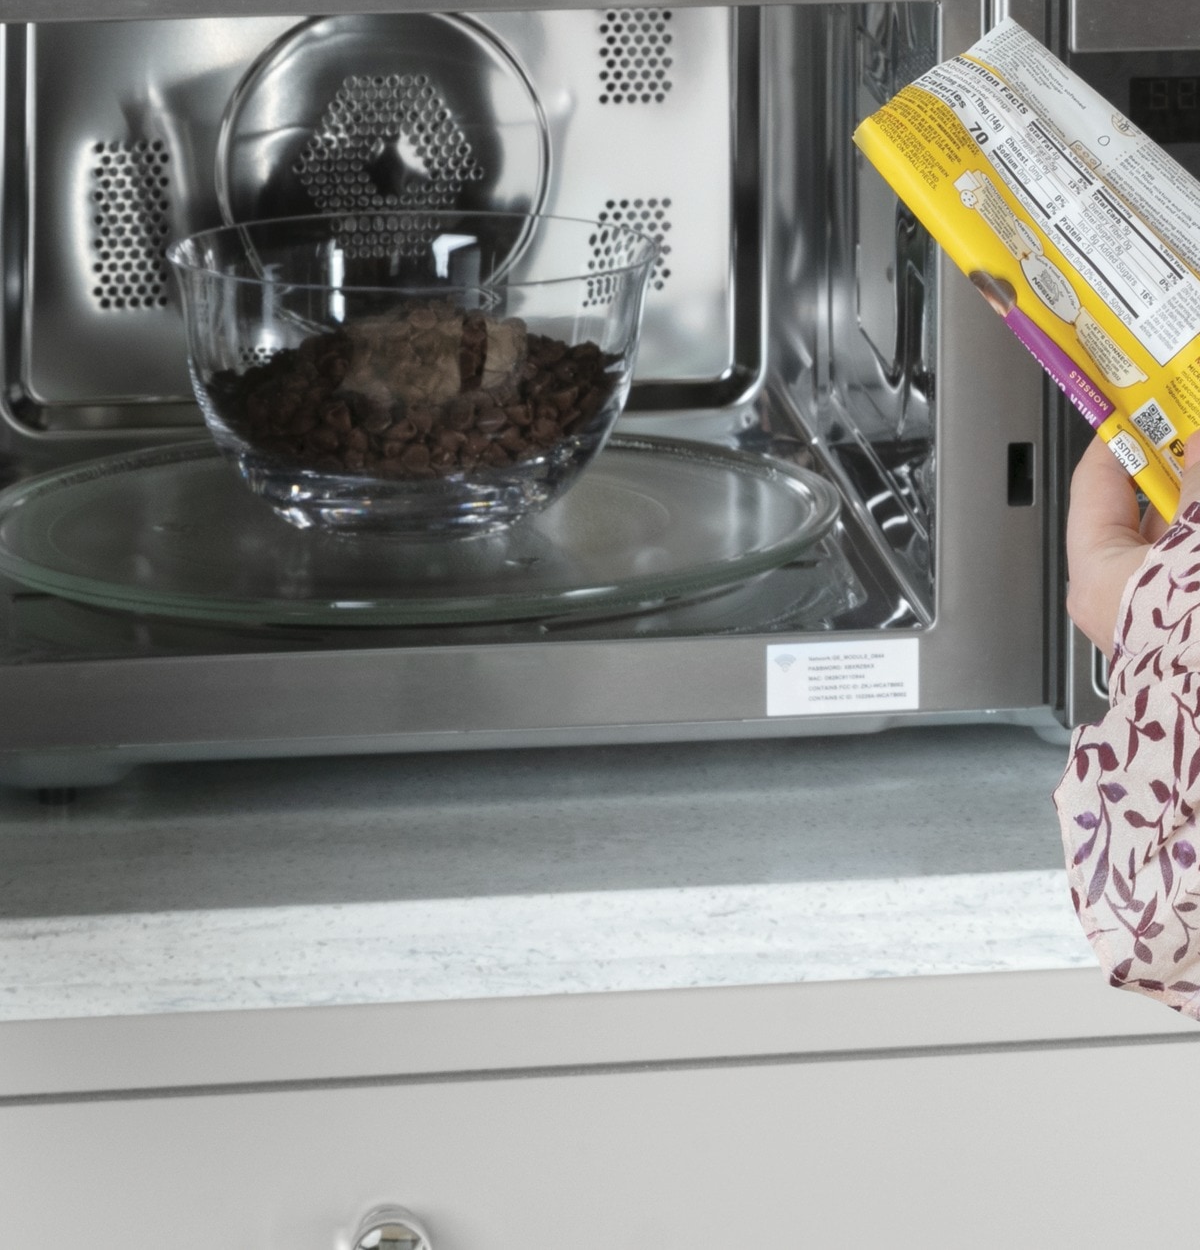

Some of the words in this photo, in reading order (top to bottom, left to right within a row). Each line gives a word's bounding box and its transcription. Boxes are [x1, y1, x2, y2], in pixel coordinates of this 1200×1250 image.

[921, 76, 966, 108] Calories
[929, 87, 956, 108] serving
[931, 70, 957, 86] Serving
[957, 84, 971, 94] size
[975, 97, 989, 115] Tbsp
[986, 114, 1005, 132] (14g)
[945, 63, 970, 76] About
[981, 84, 1012, 113] servings
[953, 56, 1000, 87] Nutrition
[1000, 86, 1030, 114] Facts
[969, 122, 989, 145] 70
[1027, 123, 1043, 140] Total
[1041, 139, 1053, 151] Fat
[1051, 152, 1060, 160] 4g
[1077, 178, 1088, 190] 5%
[996, 144, 1018, 170] Sodium
[1015, 168, 1031, 185] 0mg
[1046, 202, 1057, 215] 0%
[1005, 137, 1029, 166] Cholest.
[1028, 165, 1043, 181] 0mg
[1054, 195, 1066, 208] 0%
[1068, 180, 1081, 195] 13%
[1059, 217, 1082, 242] Protein
[1082, 208, 1097, 225] Total
[1095, 224, 1116, 246] Sugars
[1115, 245, 1124, 256] 8g
[1087, 203, 1110, 227] Dietary
[1109, 224, 1124, 240] Fiber
[1123, 240, 1132, 251] 0g
[1159, 279, 1170, 292] 0%
[1092, 192, 1108, 209] Total
[1106, 208, 1121, 226] Carb.
[1122, 226, 1132, 236] 9g
[1167, 272, 1178, 285] 3%
[1077, 220, 1091, 236] Incl.
[1090, 234, 1100, 245] 8g
[1098, 243, 1119, 264] Added
[1114, 262, 1137, 286] Sugars
[1140, 289, 1154, 306] 16%
[1090, 323, 1105, 340] LET'S
[1104, 339, 1132, 367] CONNECT
[1068, 371, 1108, 410] MORSELS
[1115, 437, 1141, 469] HOUSE
